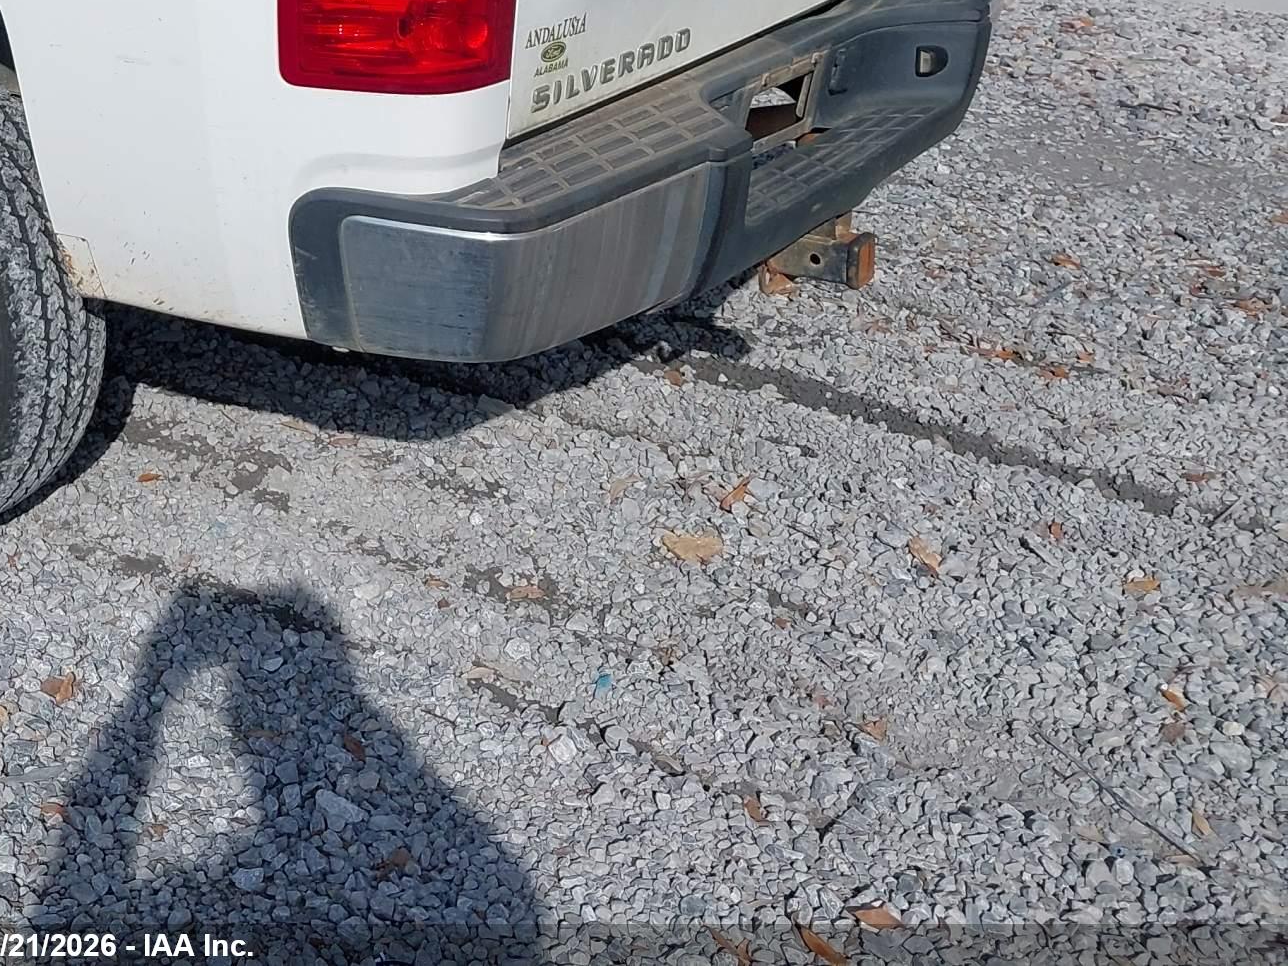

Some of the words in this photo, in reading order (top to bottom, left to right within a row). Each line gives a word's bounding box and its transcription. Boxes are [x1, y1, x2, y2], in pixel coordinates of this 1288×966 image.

[525, 12, 588, 49] ANDALUSIA
[530, 28, 691, 113] SILVERADO
[533, 57, 569, 78] ALABAMA
